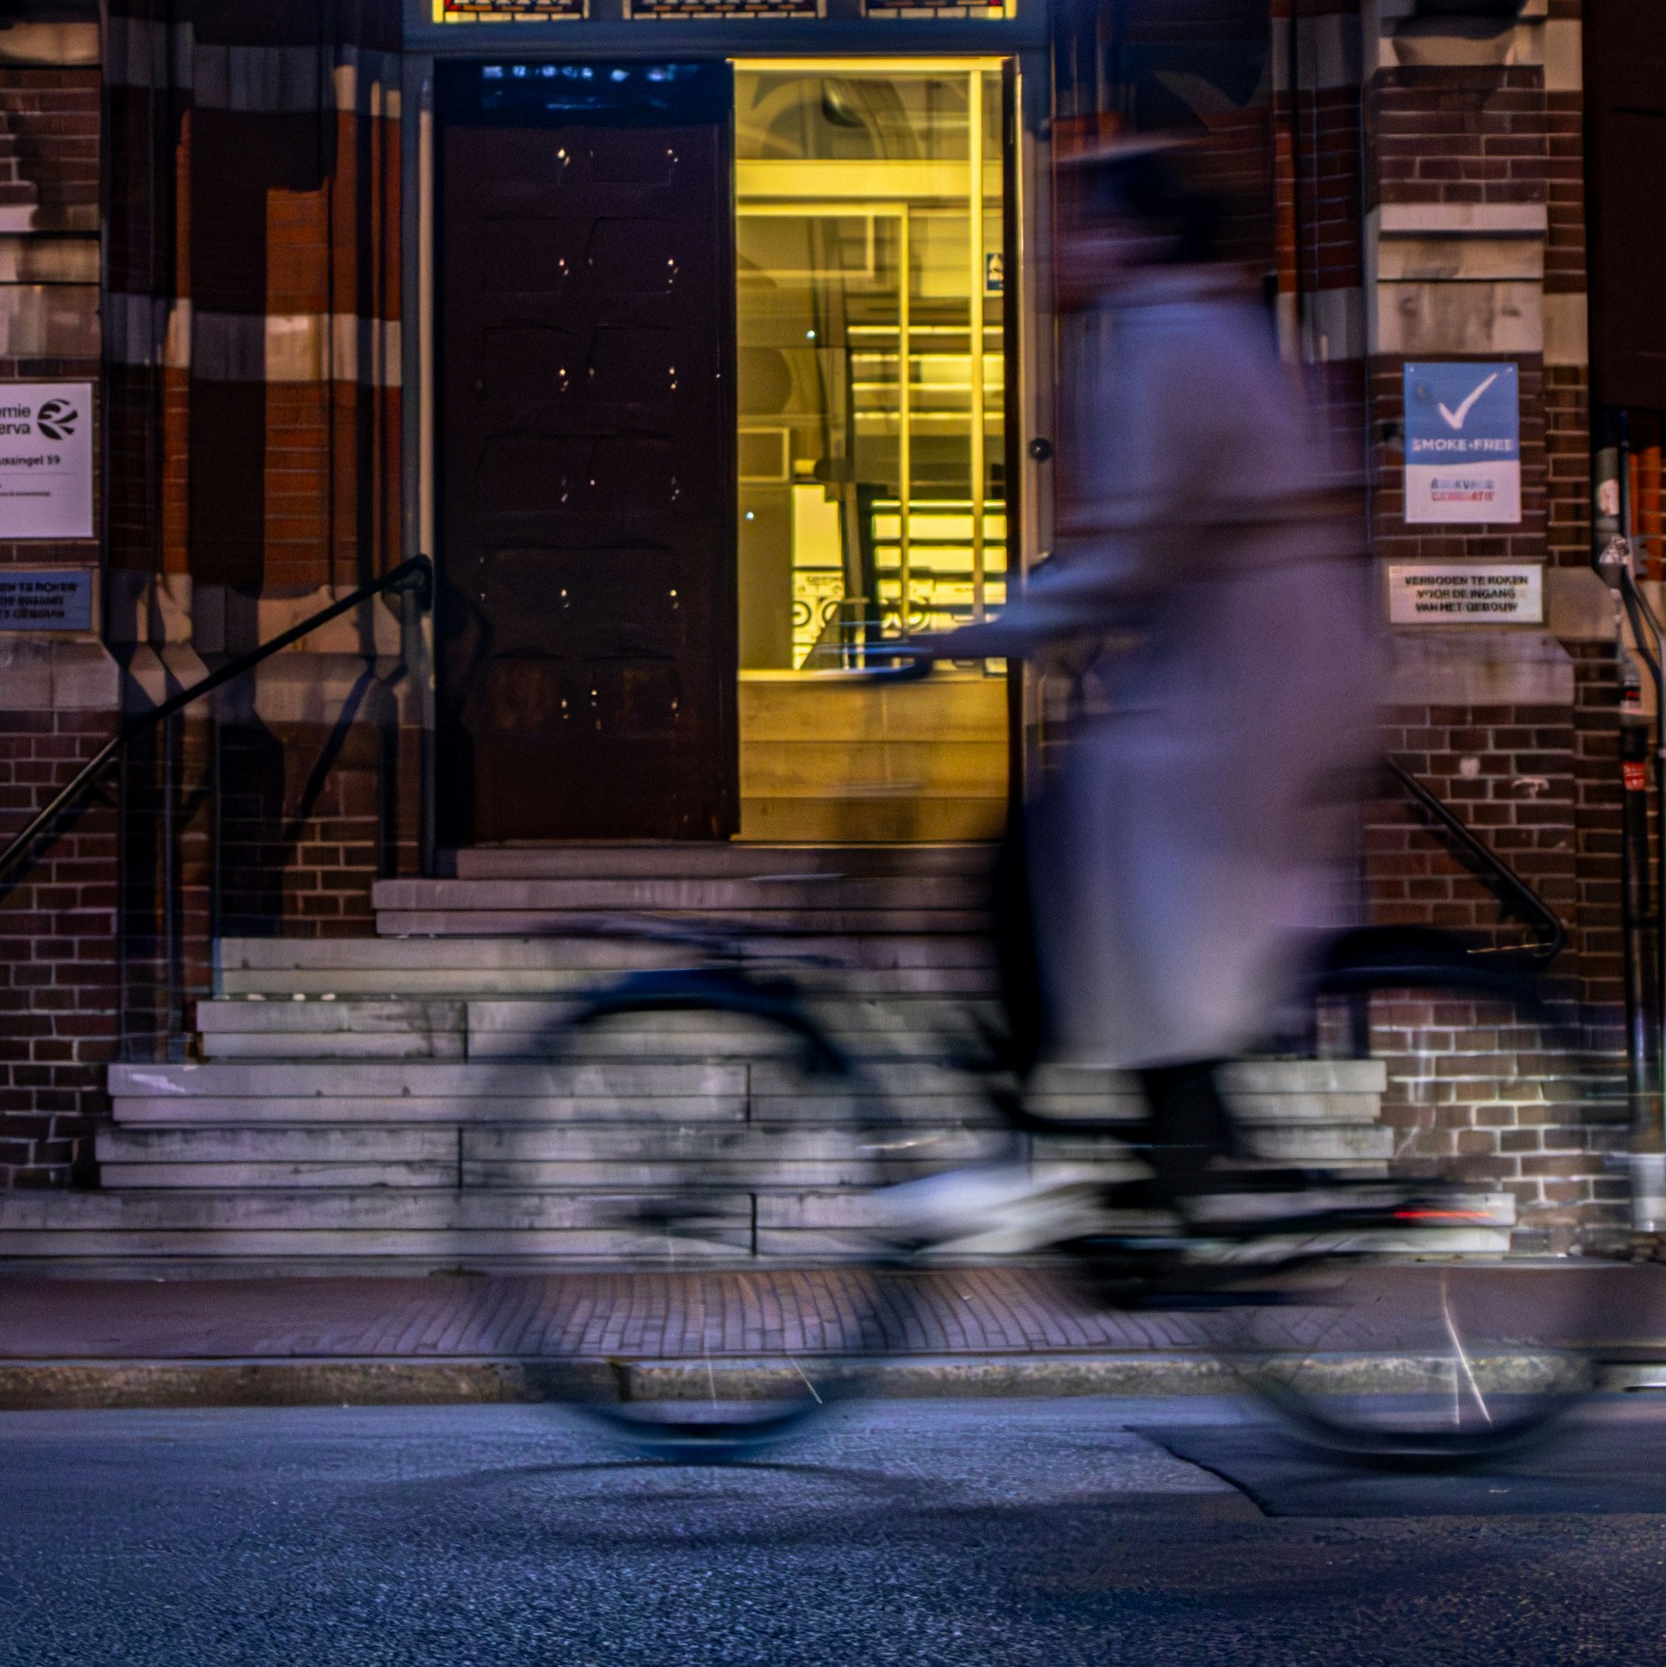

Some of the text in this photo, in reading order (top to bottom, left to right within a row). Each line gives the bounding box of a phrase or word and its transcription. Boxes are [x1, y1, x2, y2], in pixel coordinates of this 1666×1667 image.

[1405, 575, 1528, 585] VERBODEN TE ROKEN
[1452, 589, 1467, 598] DE
[1470, 589, 1516, 599] INGANG
[1415, 603, 1518, 613] VAN HET GEBOUW
